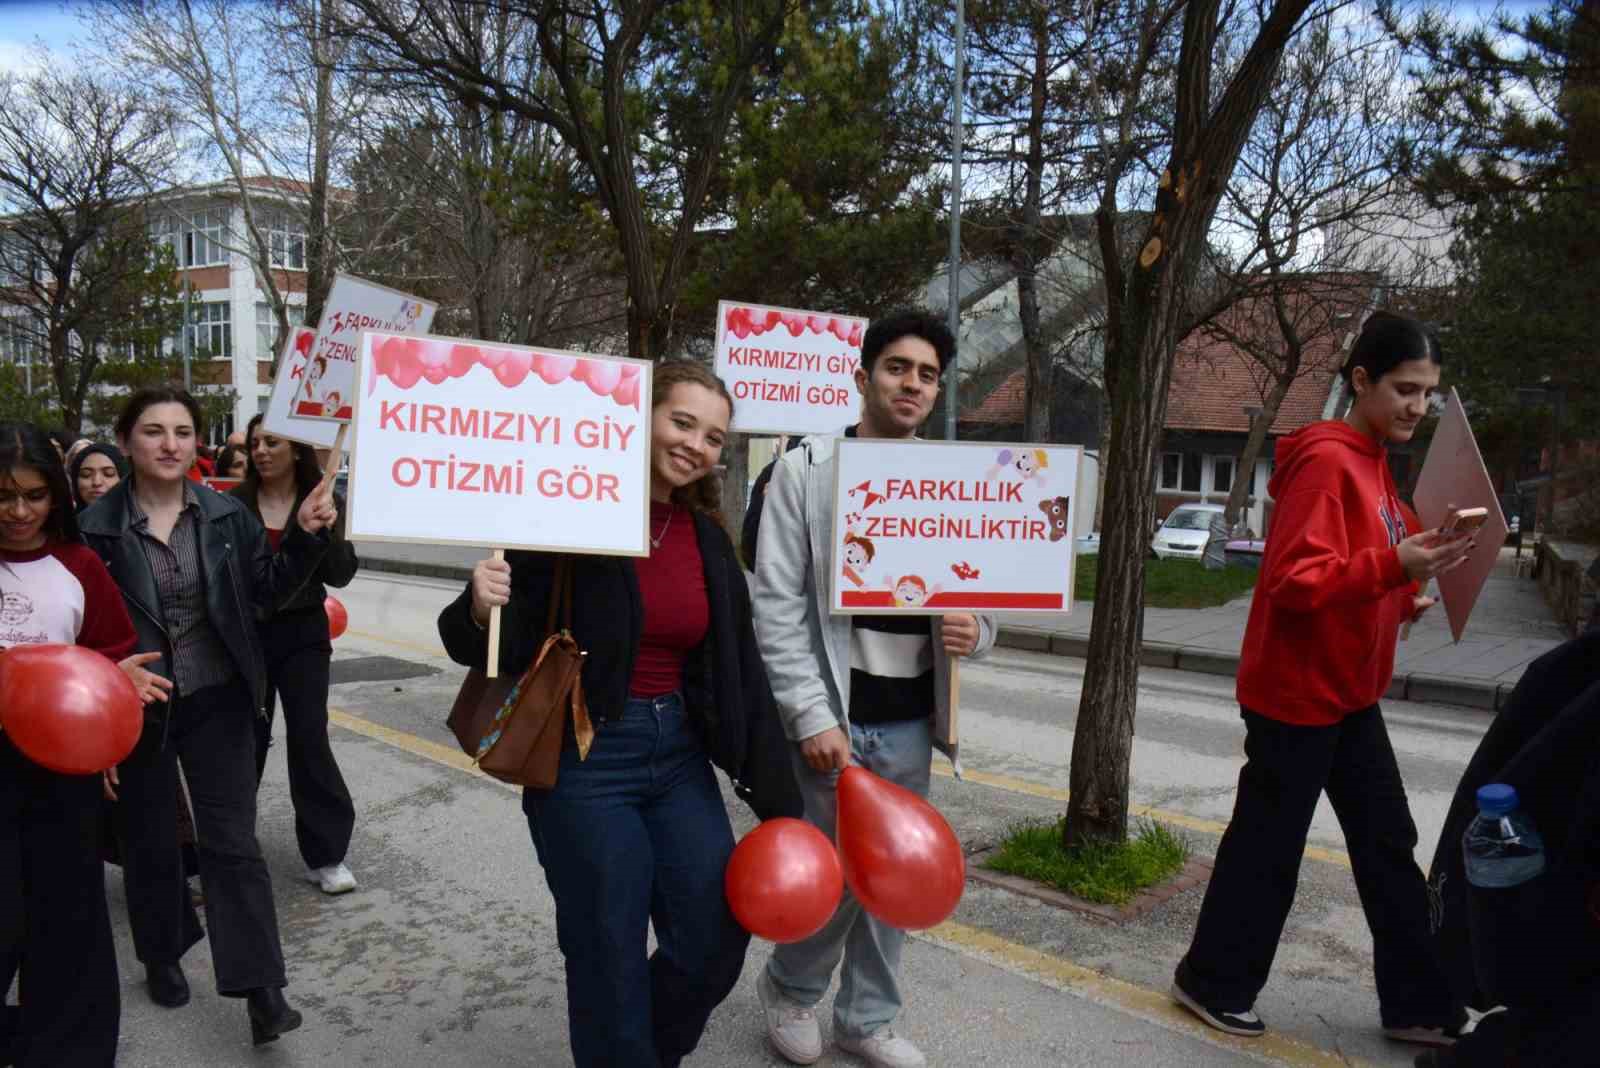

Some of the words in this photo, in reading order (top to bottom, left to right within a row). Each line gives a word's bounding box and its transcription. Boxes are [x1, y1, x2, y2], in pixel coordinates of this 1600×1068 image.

[728, 347, 821, 373] KIRMIZIYI
[827, 353, 859, 375] GİY
[734, 378, 801, 403] OTİZMİ
[807, 384, 849, 406] GÖR
[379, 400, 561, 445] KIRMIZIYI
[573, 415, 636, 451] GİY
[391, 454, 525, 495] OTİZMİ
[536, 465, 621, 502] GÖR
[886, 479, 1024, 503] FARKLILIK
[865, 513, 1046, 541] ZENGİNLİKTİR
